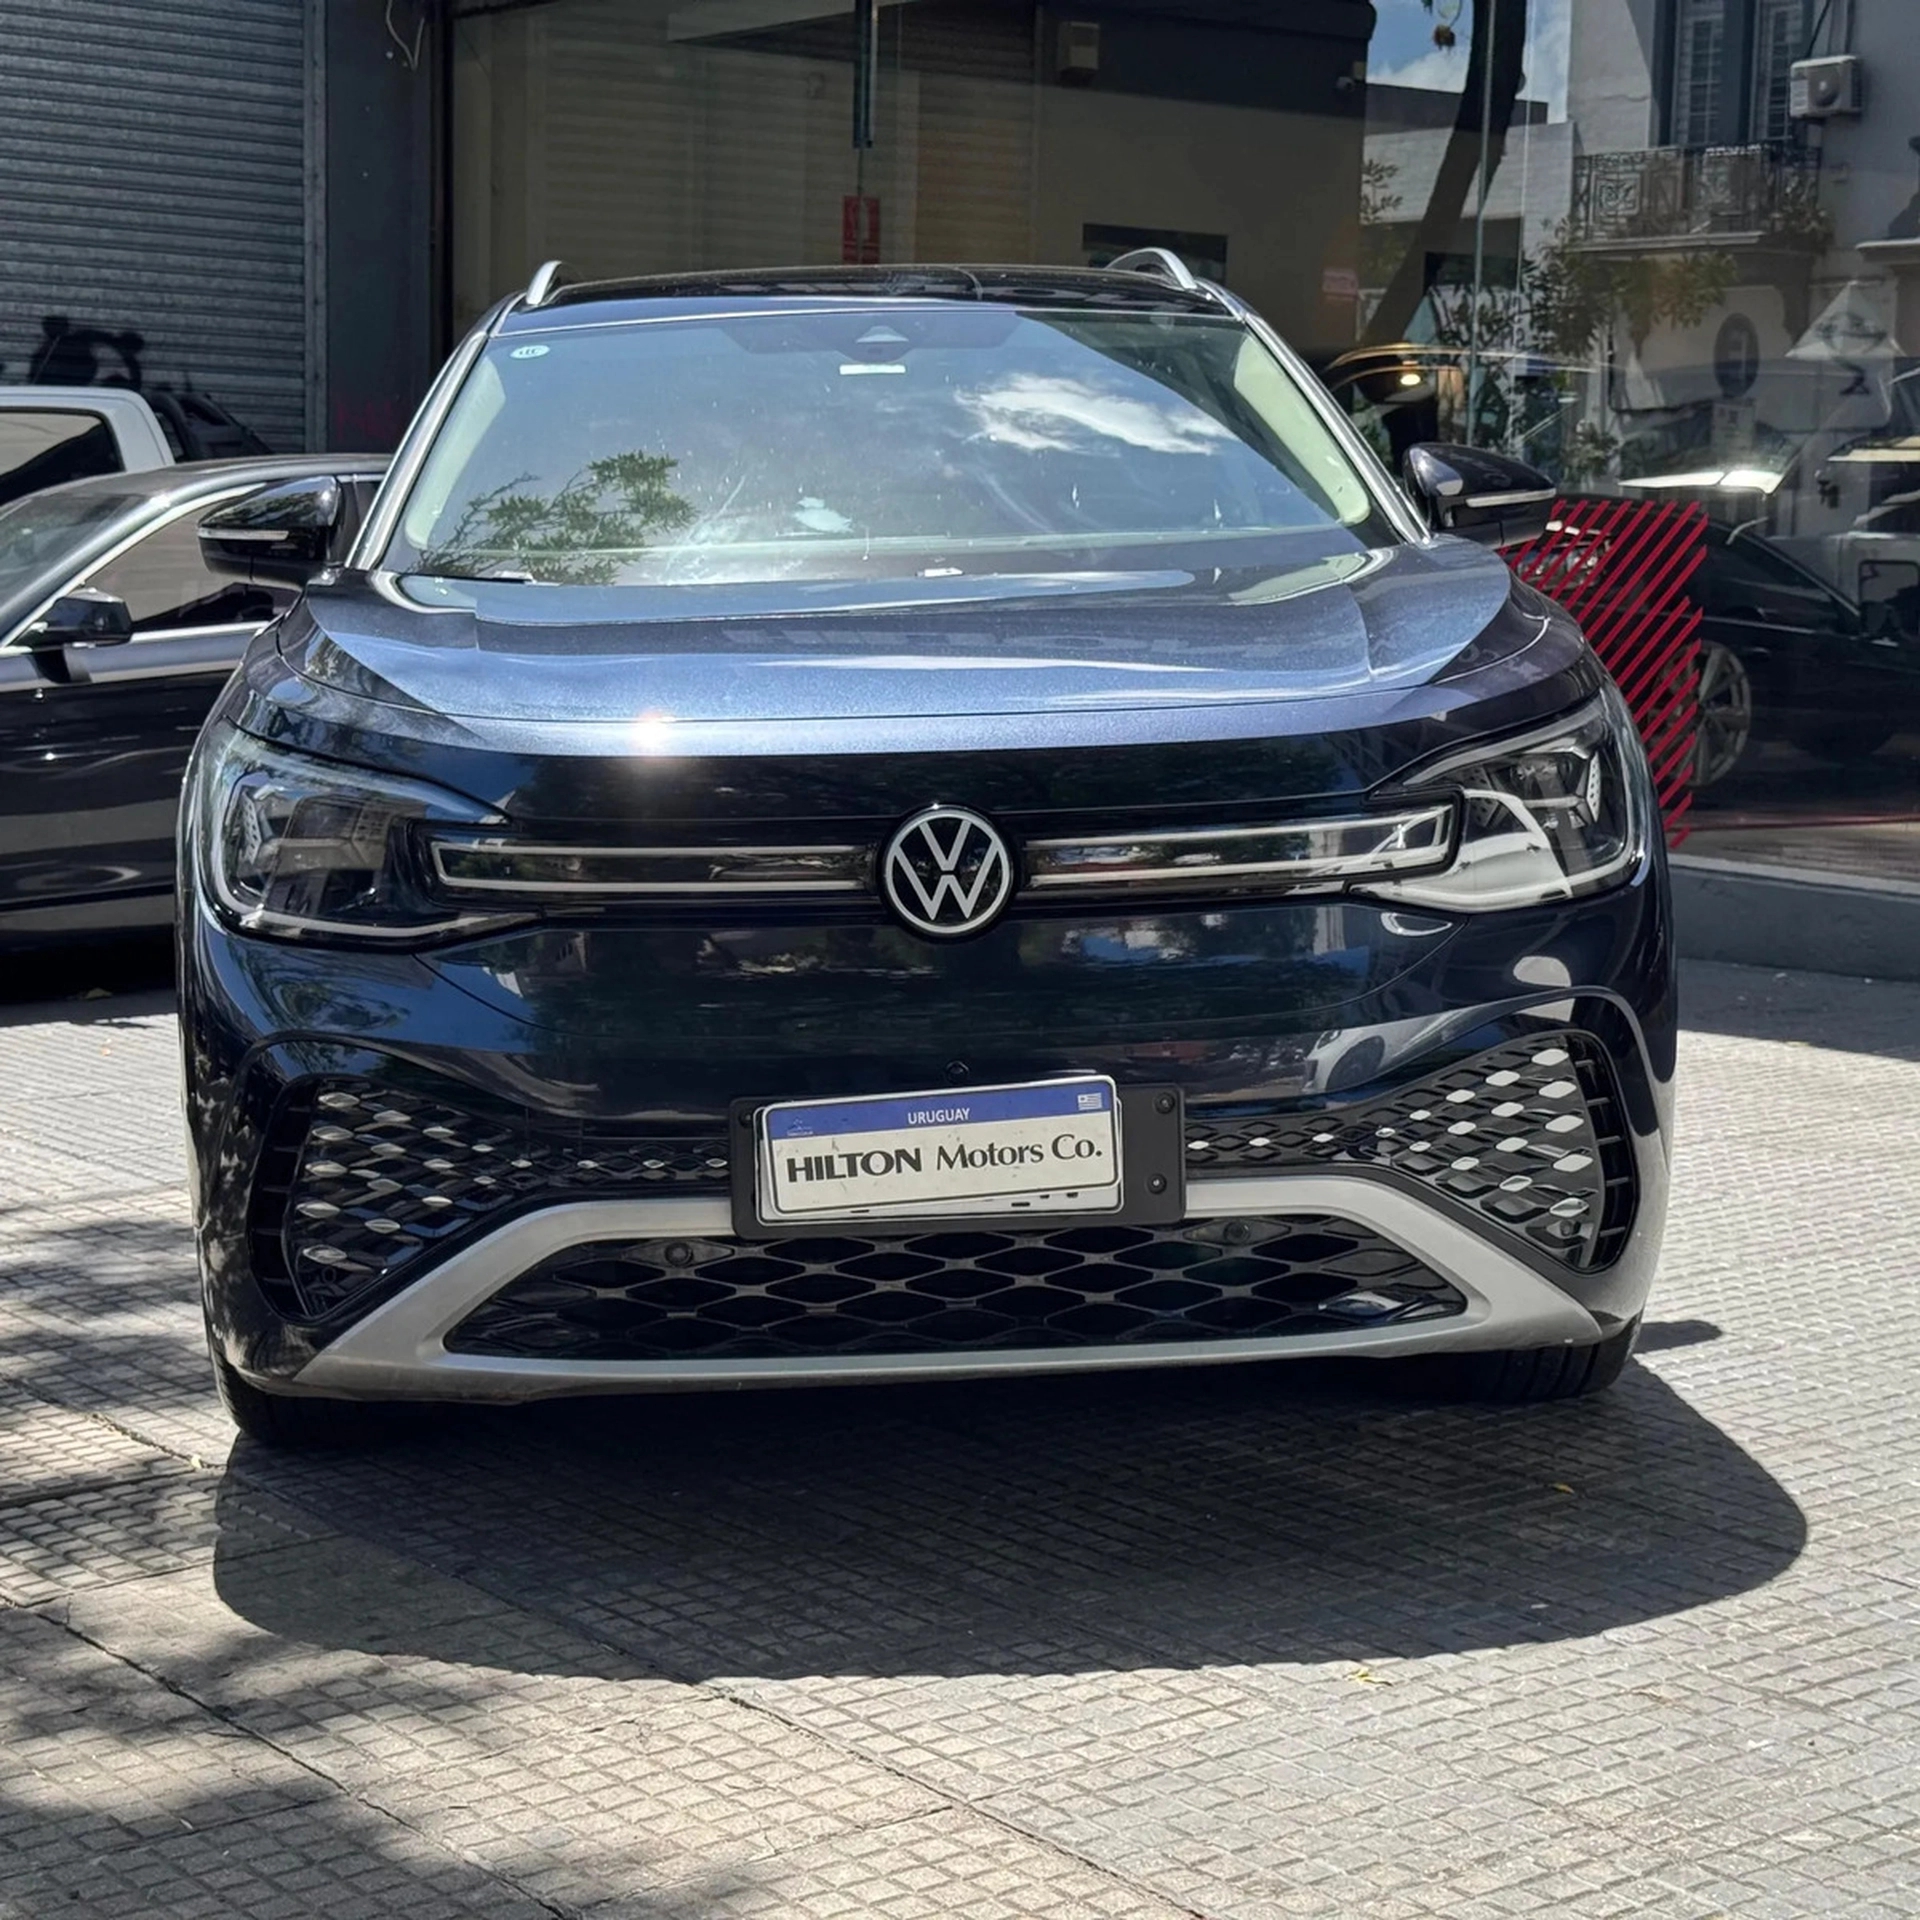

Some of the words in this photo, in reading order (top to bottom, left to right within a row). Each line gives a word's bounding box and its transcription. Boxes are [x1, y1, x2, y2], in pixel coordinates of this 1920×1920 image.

[907, 1107, 970, 1124] URUGUAY
[787, 1148, 922, 1182] HILTON
[937, 1142, 1044, 1170] Motors
[1051, 1134, 1103, 1160] Co.
